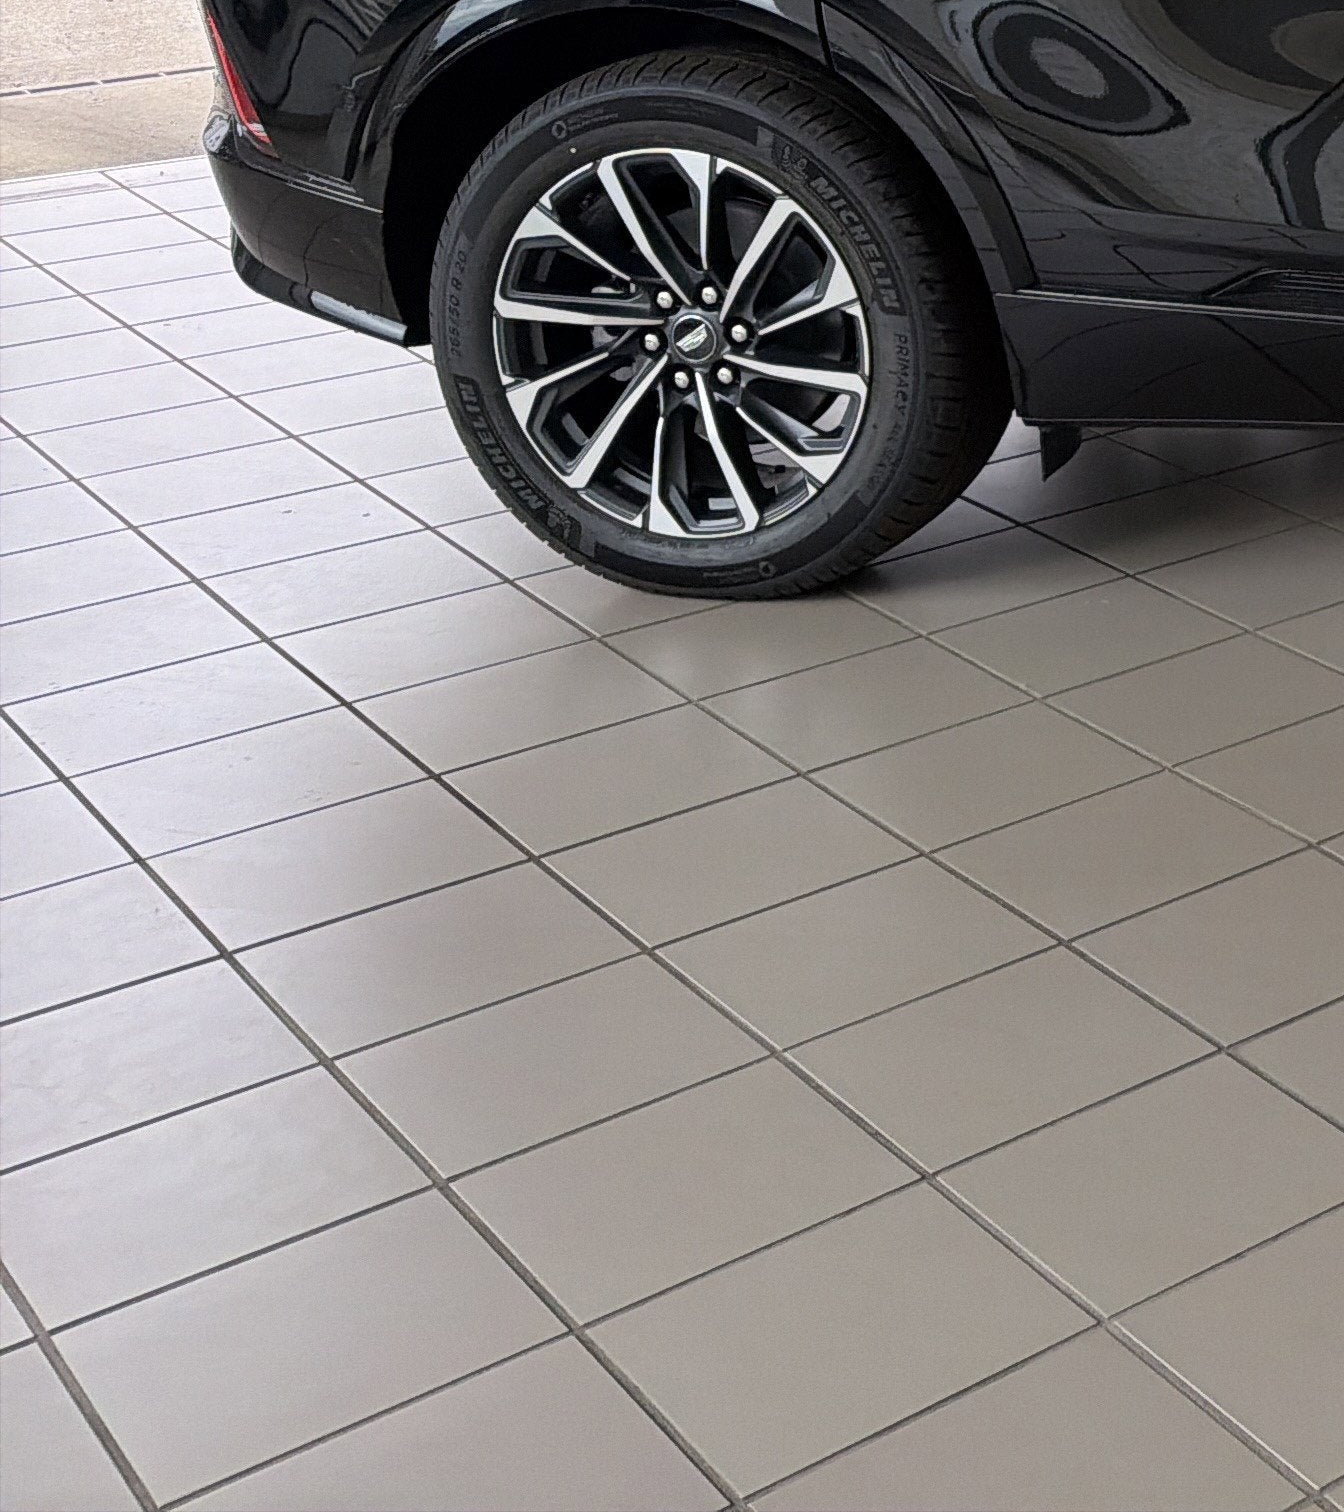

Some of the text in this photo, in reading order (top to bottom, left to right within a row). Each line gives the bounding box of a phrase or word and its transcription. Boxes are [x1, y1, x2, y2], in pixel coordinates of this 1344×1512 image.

[810, 176, 900, 308] MICHELIN
[894, 333, 911, 416] PRIMACY
[457, 381, 546, 510] MICHELIN
